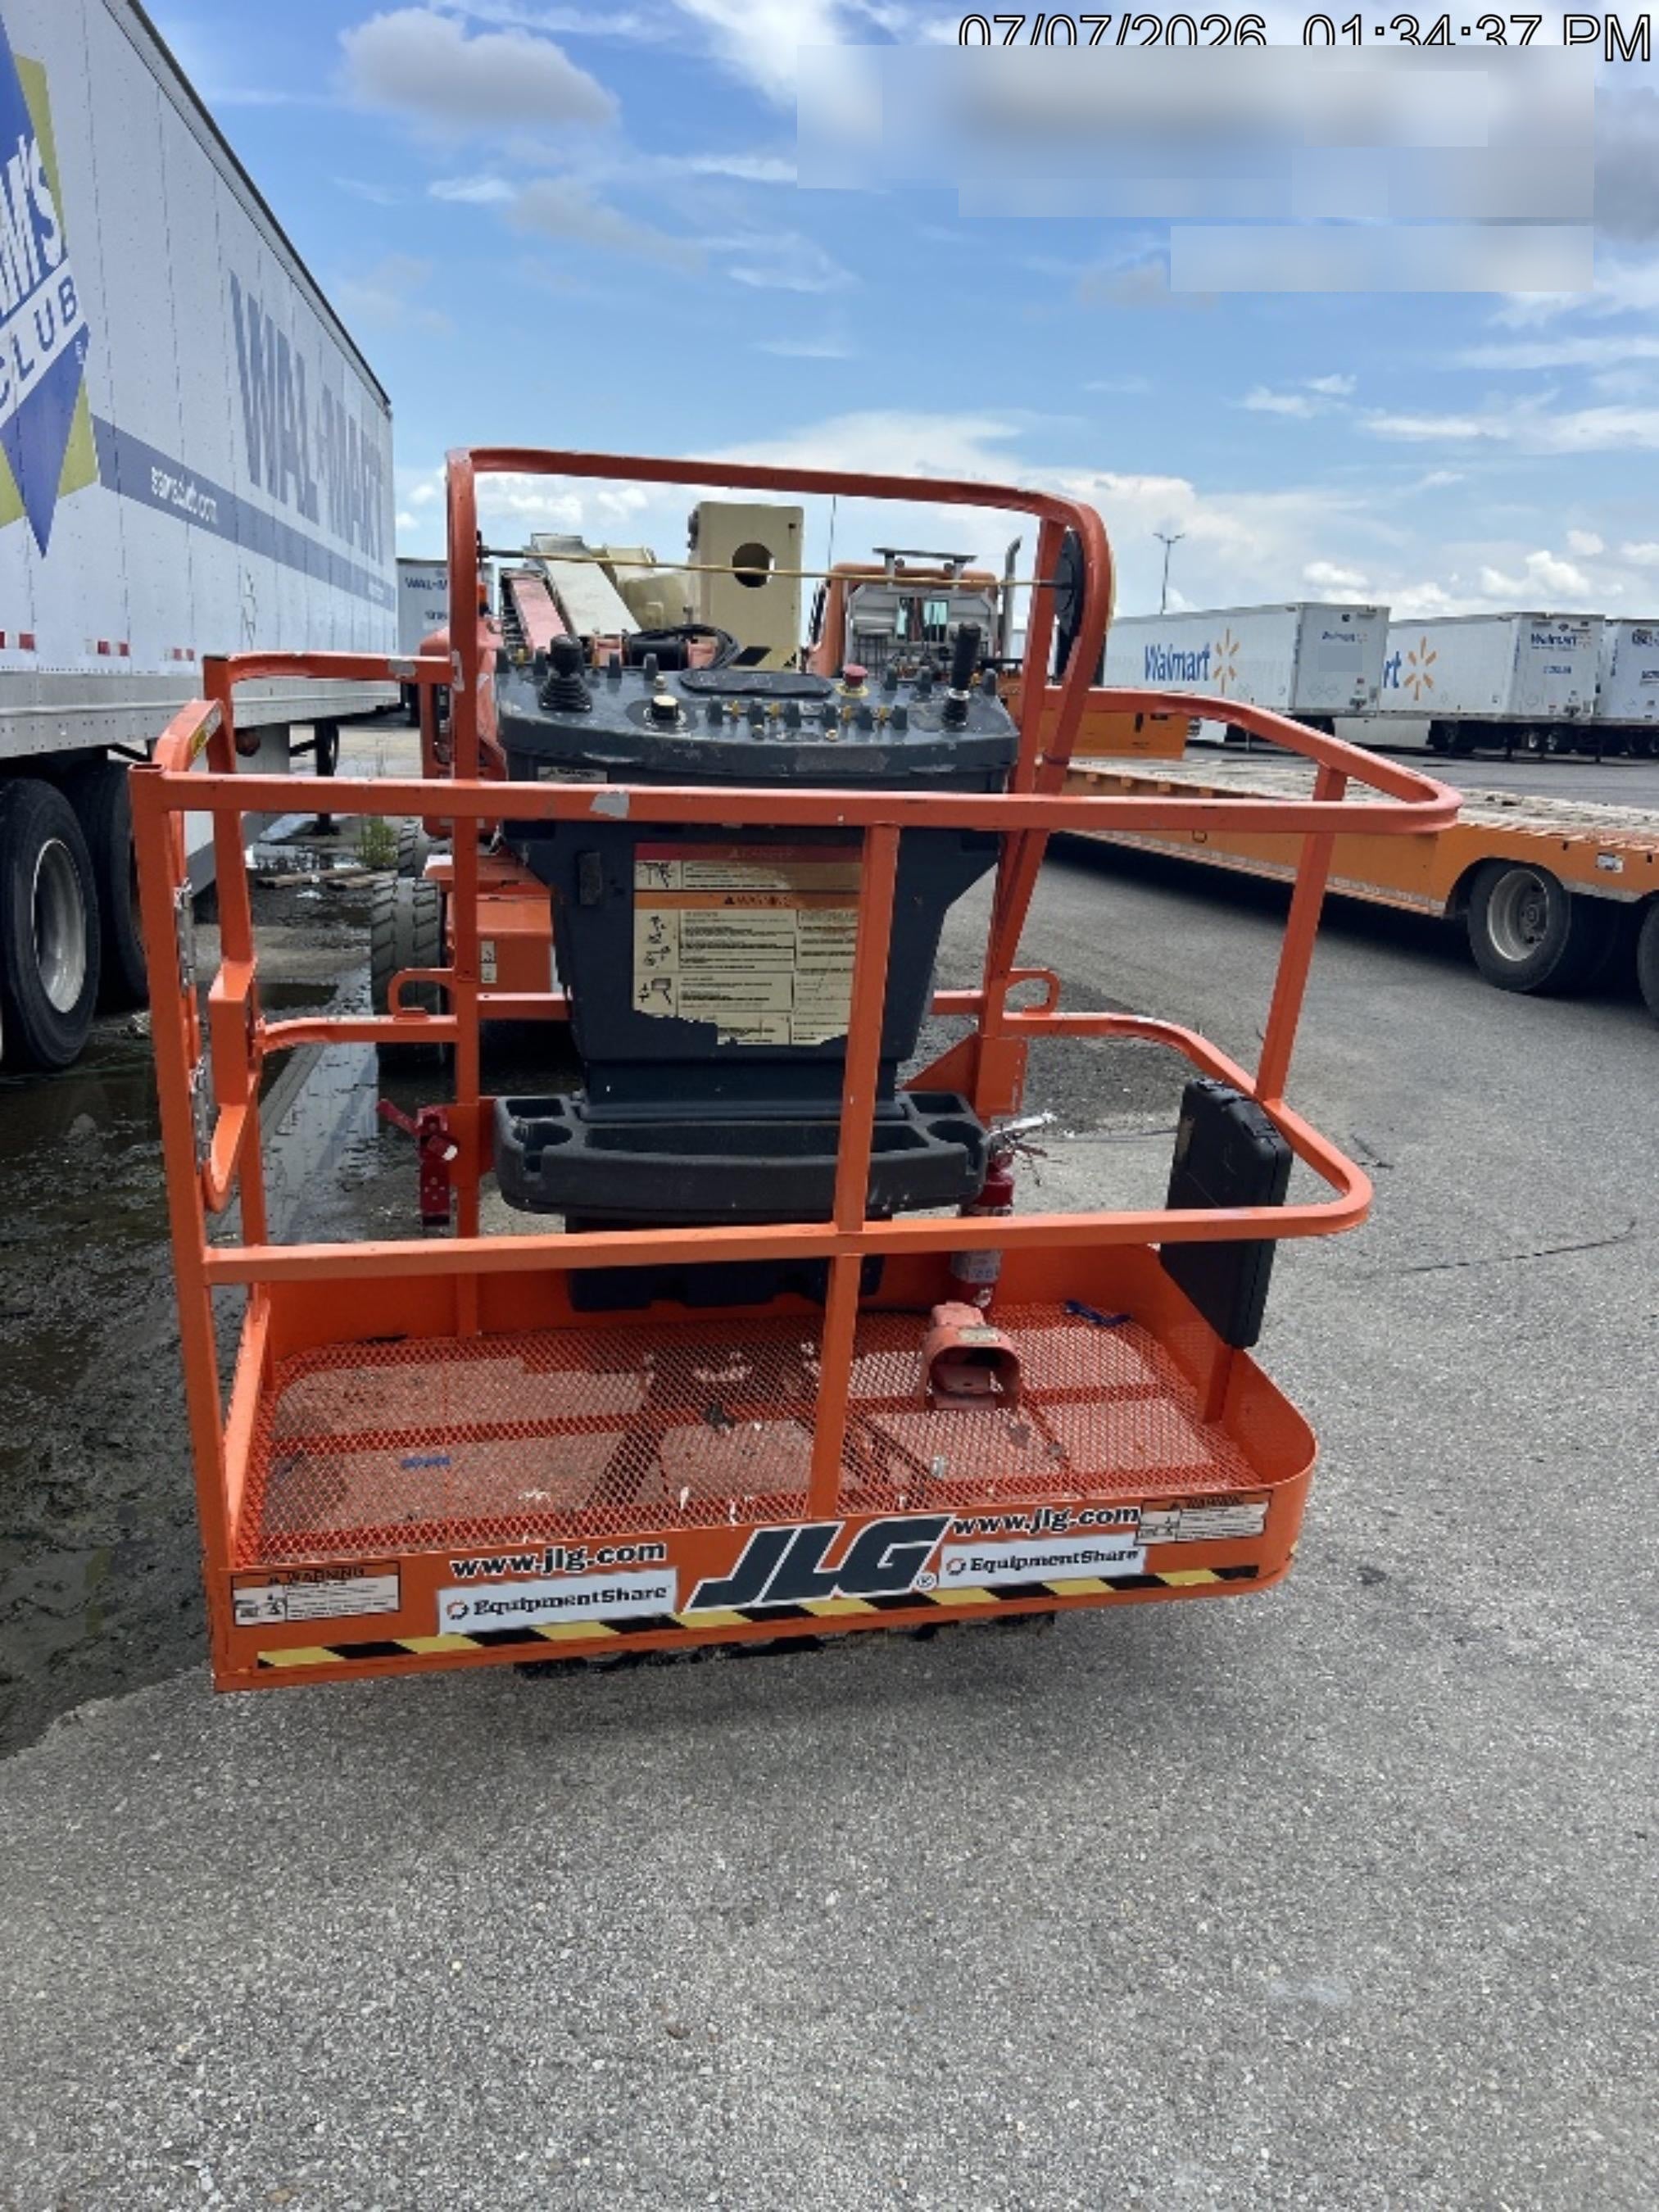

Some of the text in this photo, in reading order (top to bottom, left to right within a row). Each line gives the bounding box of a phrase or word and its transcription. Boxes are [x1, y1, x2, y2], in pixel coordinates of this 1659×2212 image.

[1145, 642, 1211, 682] Walmart
[1384, 650, 1402, 688] rt
[953, 1507, 1140, 1536] www.jlg.com
[449, 1543, 667, 1578] www.jlg.com
[685, 1515, 955, 1612] JLG
[970, 1549, 1139, 1574] EquipmentShare
[473, 1586, 667, 1616] EquipmentShare
